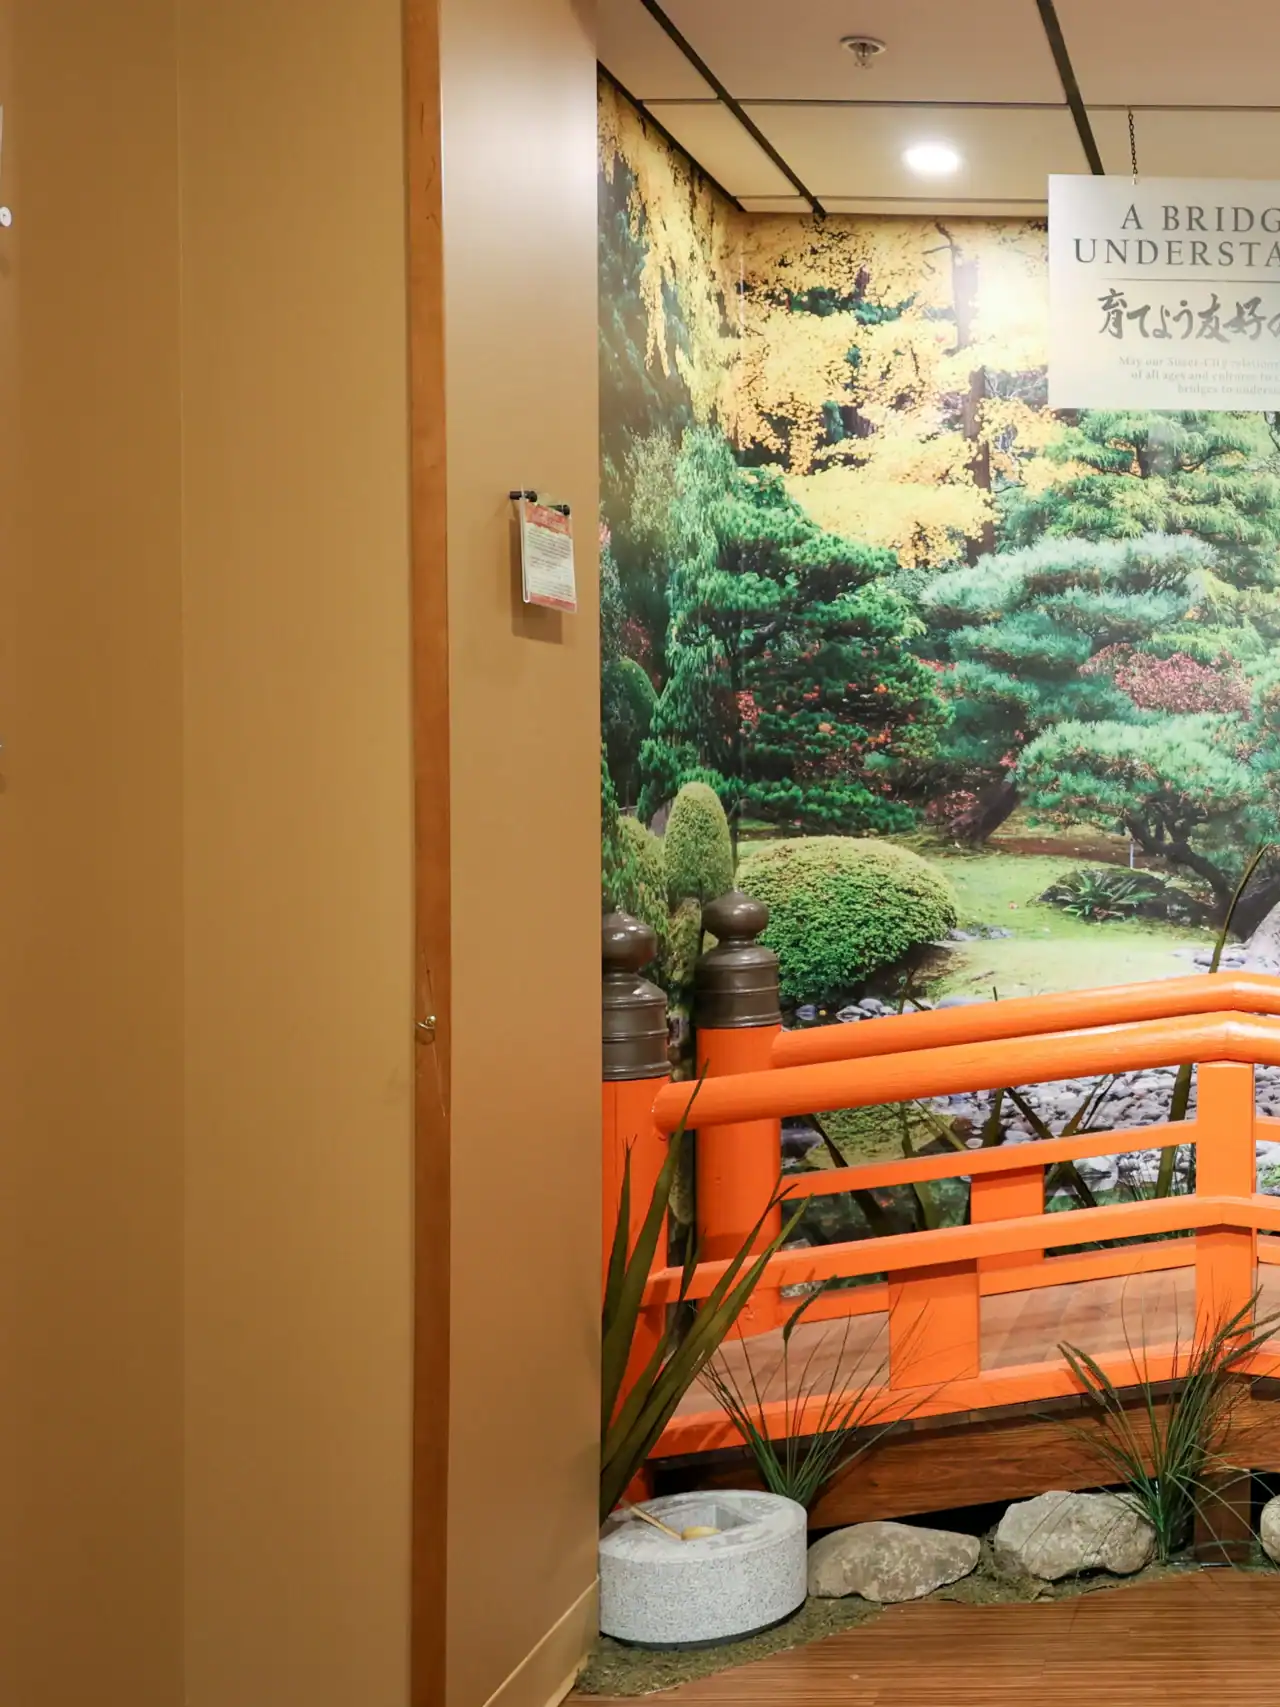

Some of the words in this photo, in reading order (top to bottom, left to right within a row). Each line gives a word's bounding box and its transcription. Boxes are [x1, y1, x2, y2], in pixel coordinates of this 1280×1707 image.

[1119, 203, 1143, 230] A
[1118, 355, 1141, 369] May
[1145, 358, 1164, 367] our
[1131, 369, 1142, 380] of
[1145, 369, 1159, 381] all
[1163, 371, 1186, 383] ages
[1188, 370, 1209, 381] and
[1259, 371, 1272, 383] to
[1177, 383, 1218, 398] bridges
[1221, 385, 1233, 395] to
